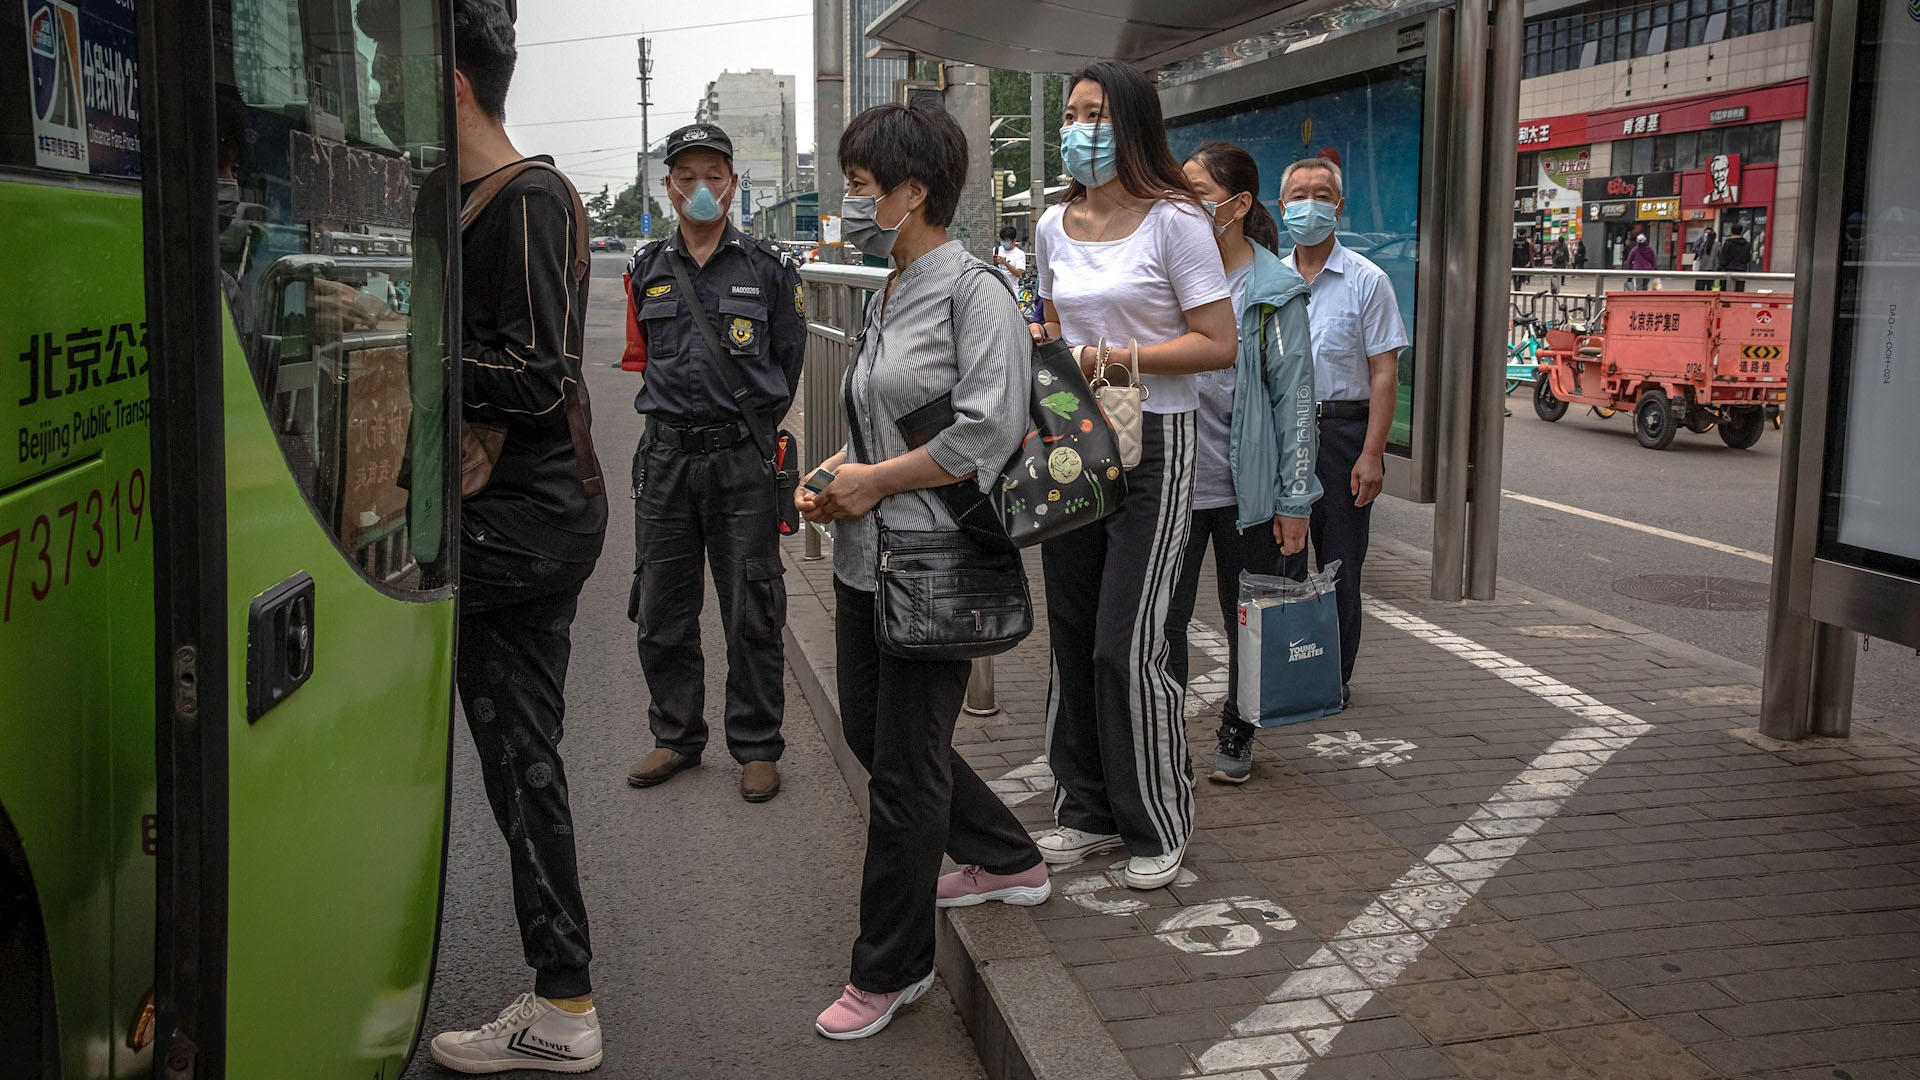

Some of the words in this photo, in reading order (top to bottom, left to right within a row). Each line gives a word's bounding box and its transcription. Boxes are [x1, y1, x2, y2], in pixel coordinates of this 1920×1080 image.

[1623, 113, 1660, 135] 肯德基
[1629, 311, 1680, 332] 北京养护集团
[18, 421, 71, 465] Beijing
[73, 403, 111, 443] Public
[1287, 647, 1324, 663] ATHLETES
[1289, 642, 1317, 656] YOUNG
[531, 1034, 572, 1053] FEIYUE
